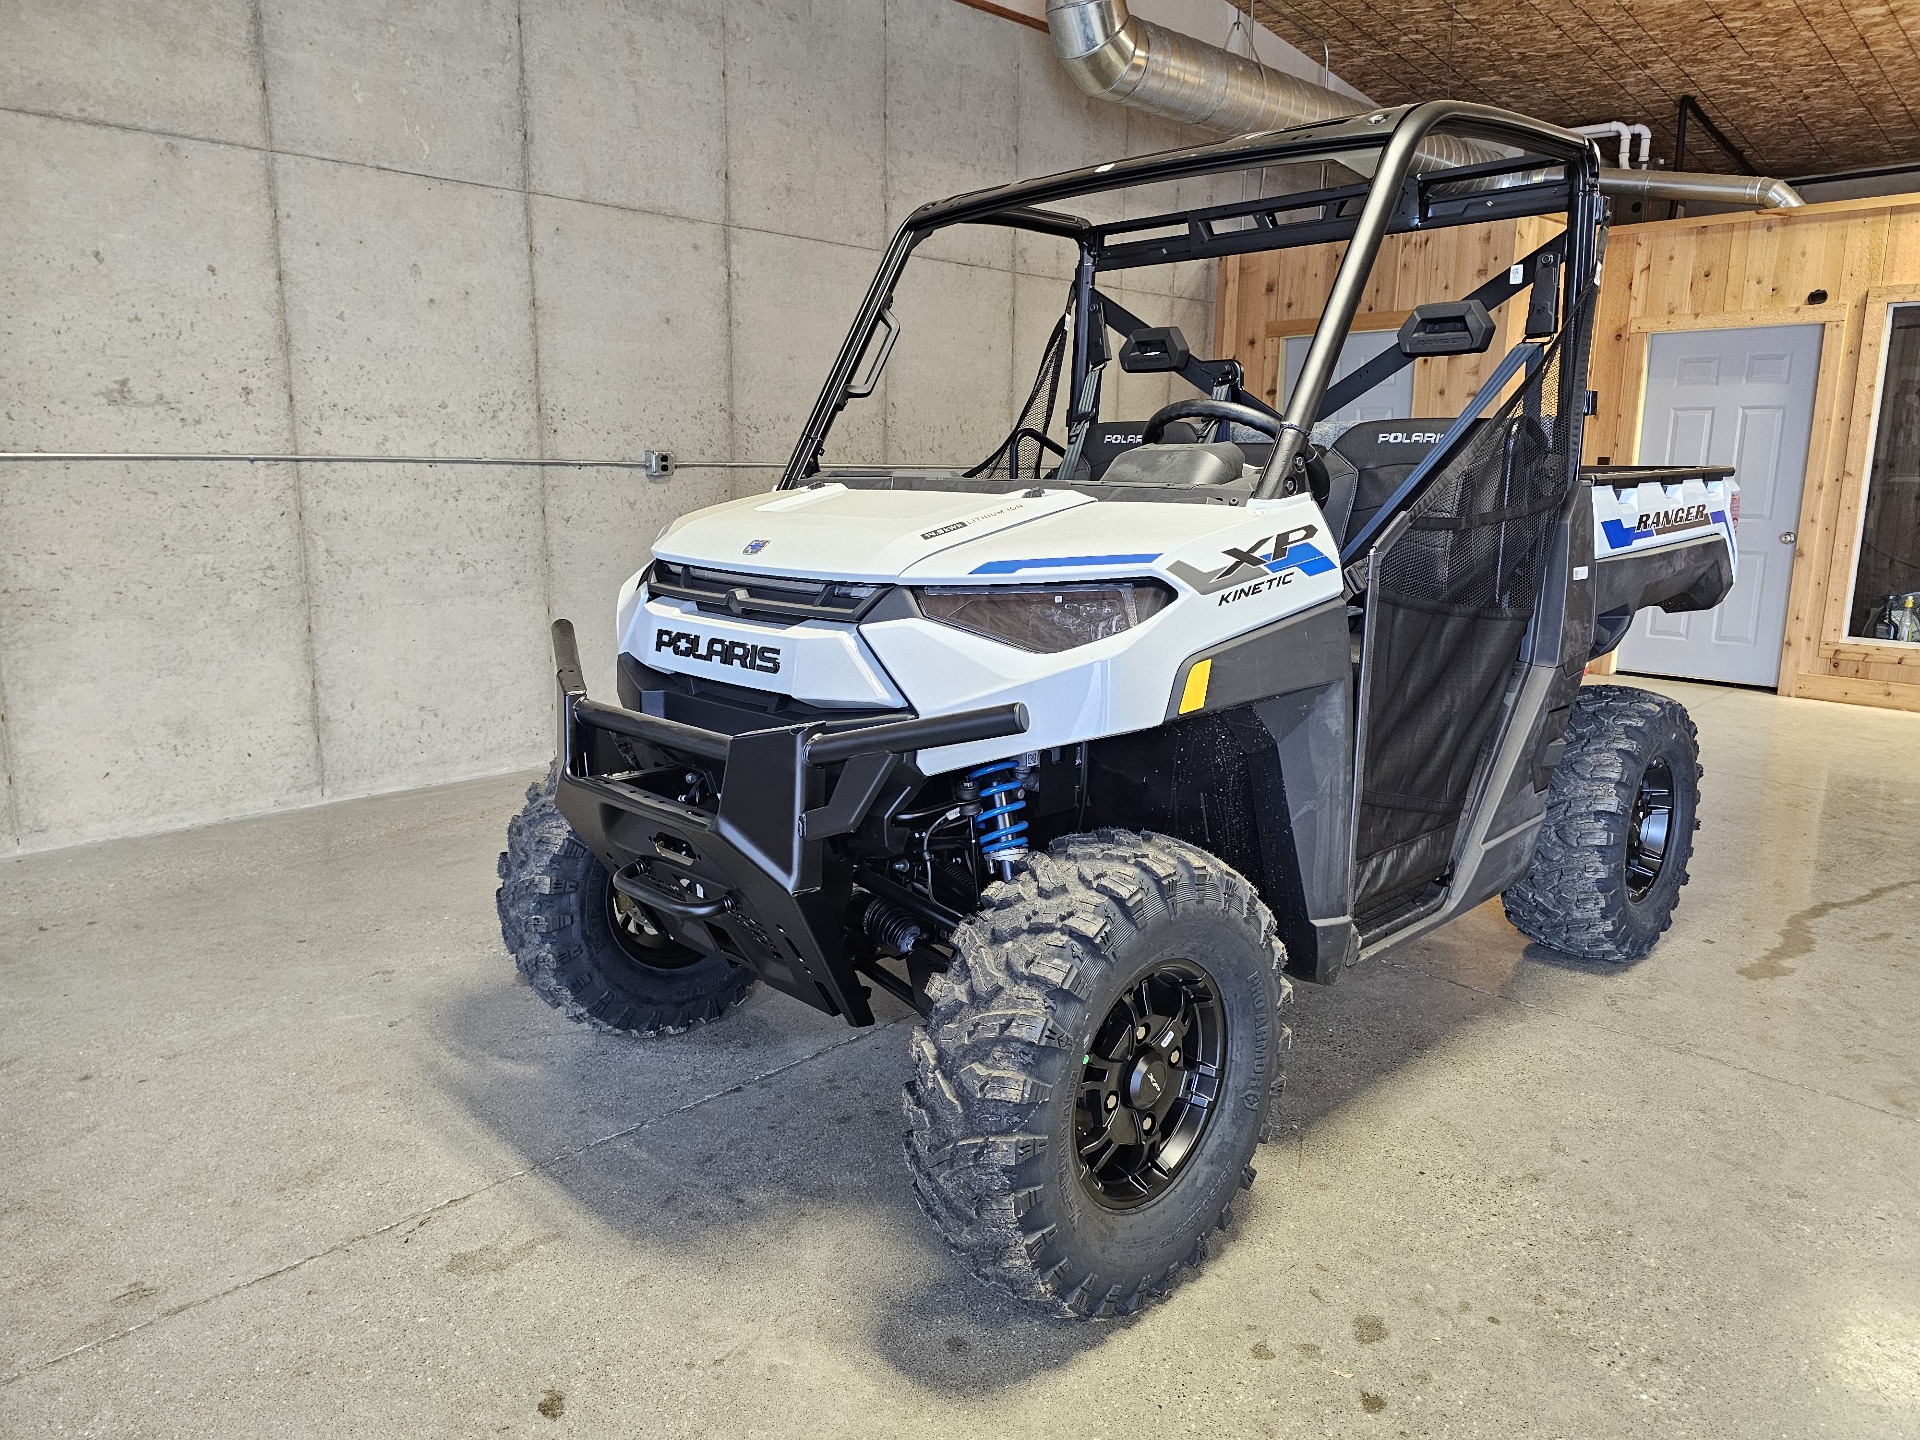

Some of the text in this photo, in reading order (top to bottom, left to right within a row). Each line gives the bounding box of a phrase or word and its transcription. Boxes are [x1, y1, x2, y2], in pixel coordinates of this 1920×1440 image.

[1103, 434, 1144, 444] POLAR
[1377, 432, 1445, 444] POLARI
[966, 509, 1005, 525] LITHIUM
[1006, 503, 1025, 512] ION
[1635, 504, 1707, 531] RANGER
[1211, 524, 1319, 582] XP
[1217, 571, 1295, 607] KINETIC
[655, 628, 782, 675] POLARIS
[1146, 1072, 1161, 1092] XP
